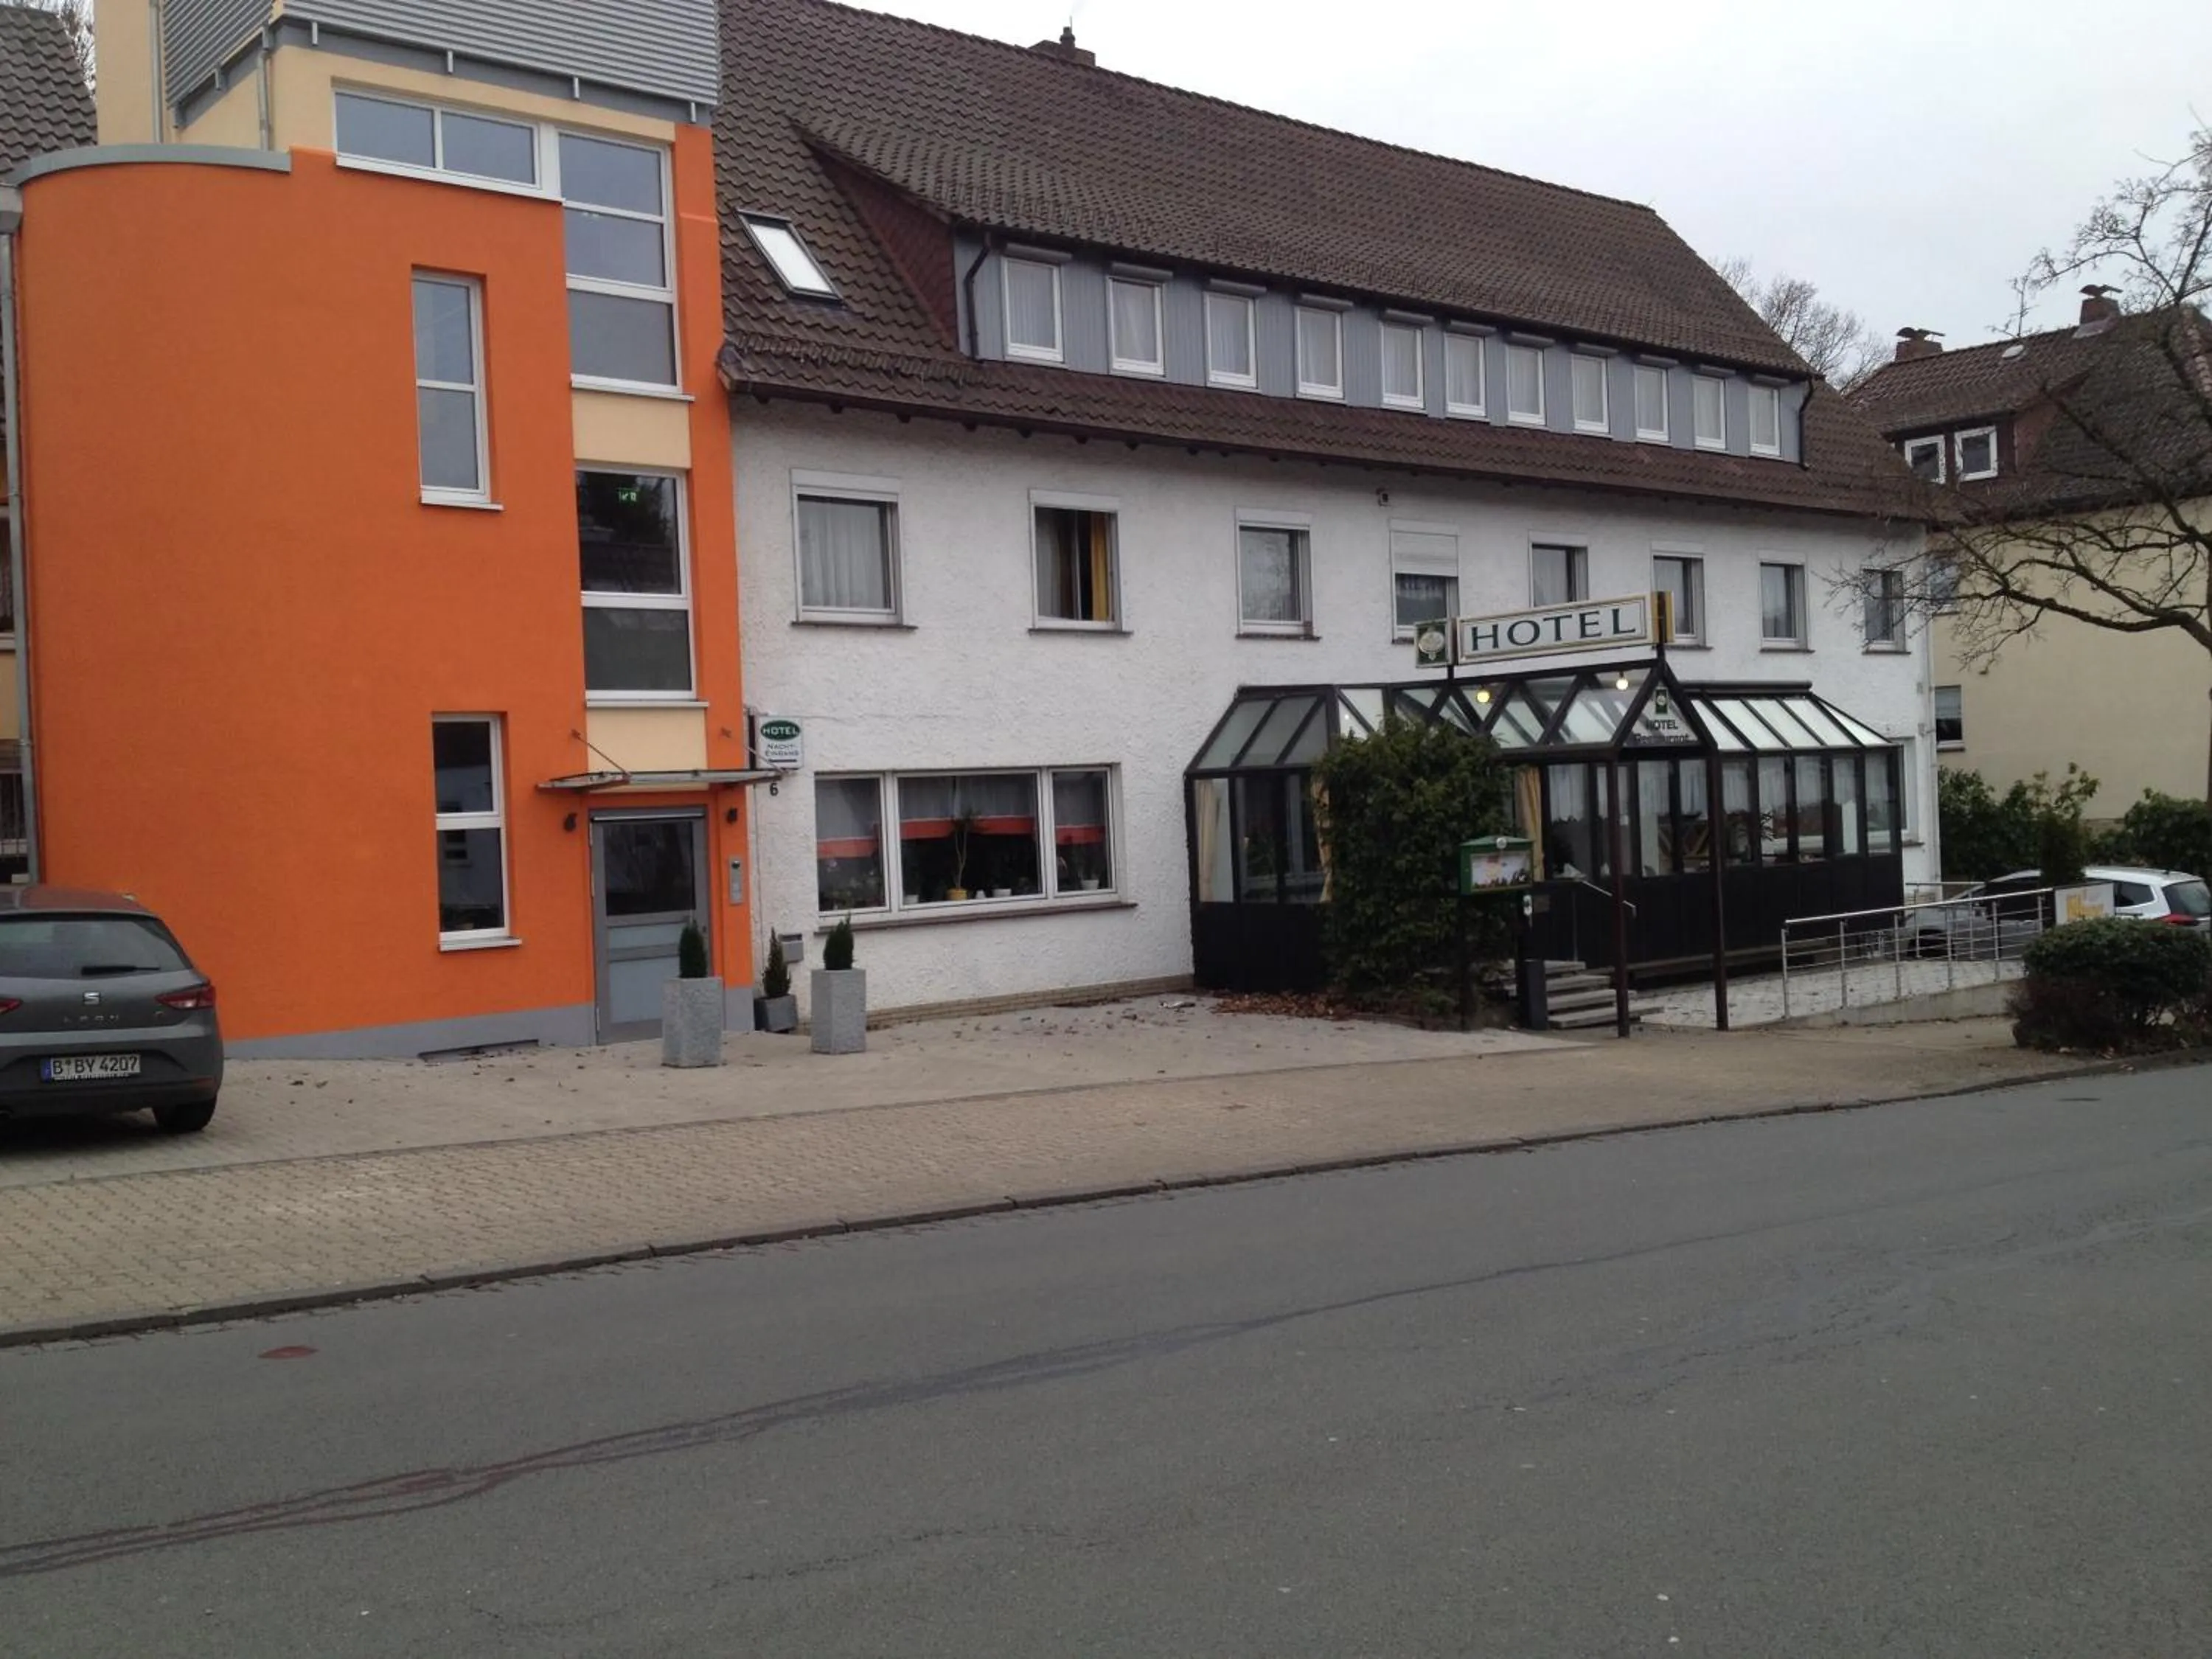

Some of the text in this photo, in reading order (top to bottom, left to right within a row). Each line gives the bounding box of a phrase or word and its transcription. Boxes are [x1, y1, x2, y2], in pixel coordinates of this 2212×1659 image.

[1471, 608, 1636, 651] HOTEL
[762, 726, 798, 735] HOTEL
[1646, 719, 1679, 731] HOTEL
[1633, 733, 1689, 744] Resurant
[770, 782, 779, 796] 6
[100, 1056, 138, 1072] 4207
